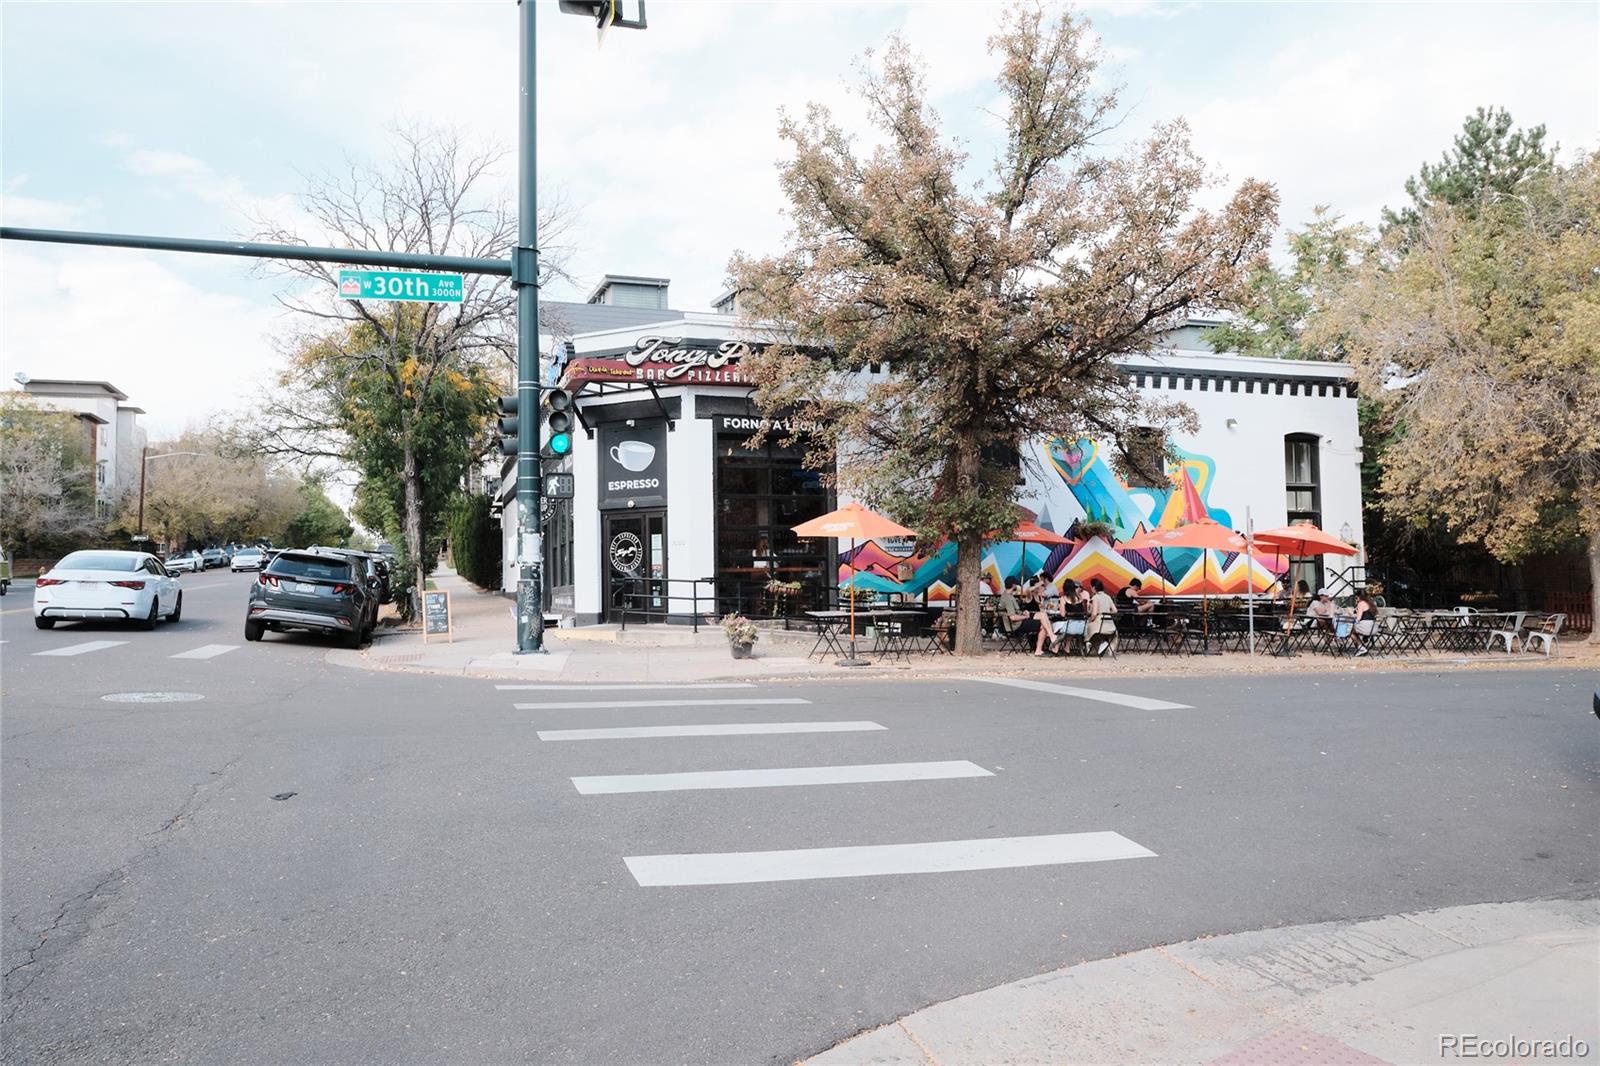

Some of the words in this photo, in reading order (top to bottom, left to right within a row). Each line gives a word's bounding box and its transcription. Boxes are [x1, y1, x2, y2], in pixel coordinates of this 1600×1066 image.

[363, 281, 372, 289] W
[374, 276, 429, 297] 30th
[438, 279, 455, 288] Ave
[432, 288, 461, 297] 3000N
[625, 335, 707, 378] Tony
[636, 368, 665, 380] BAR
[772, 420, 782, 430] A
[607, 478, 660, 492] ESPRESSO
